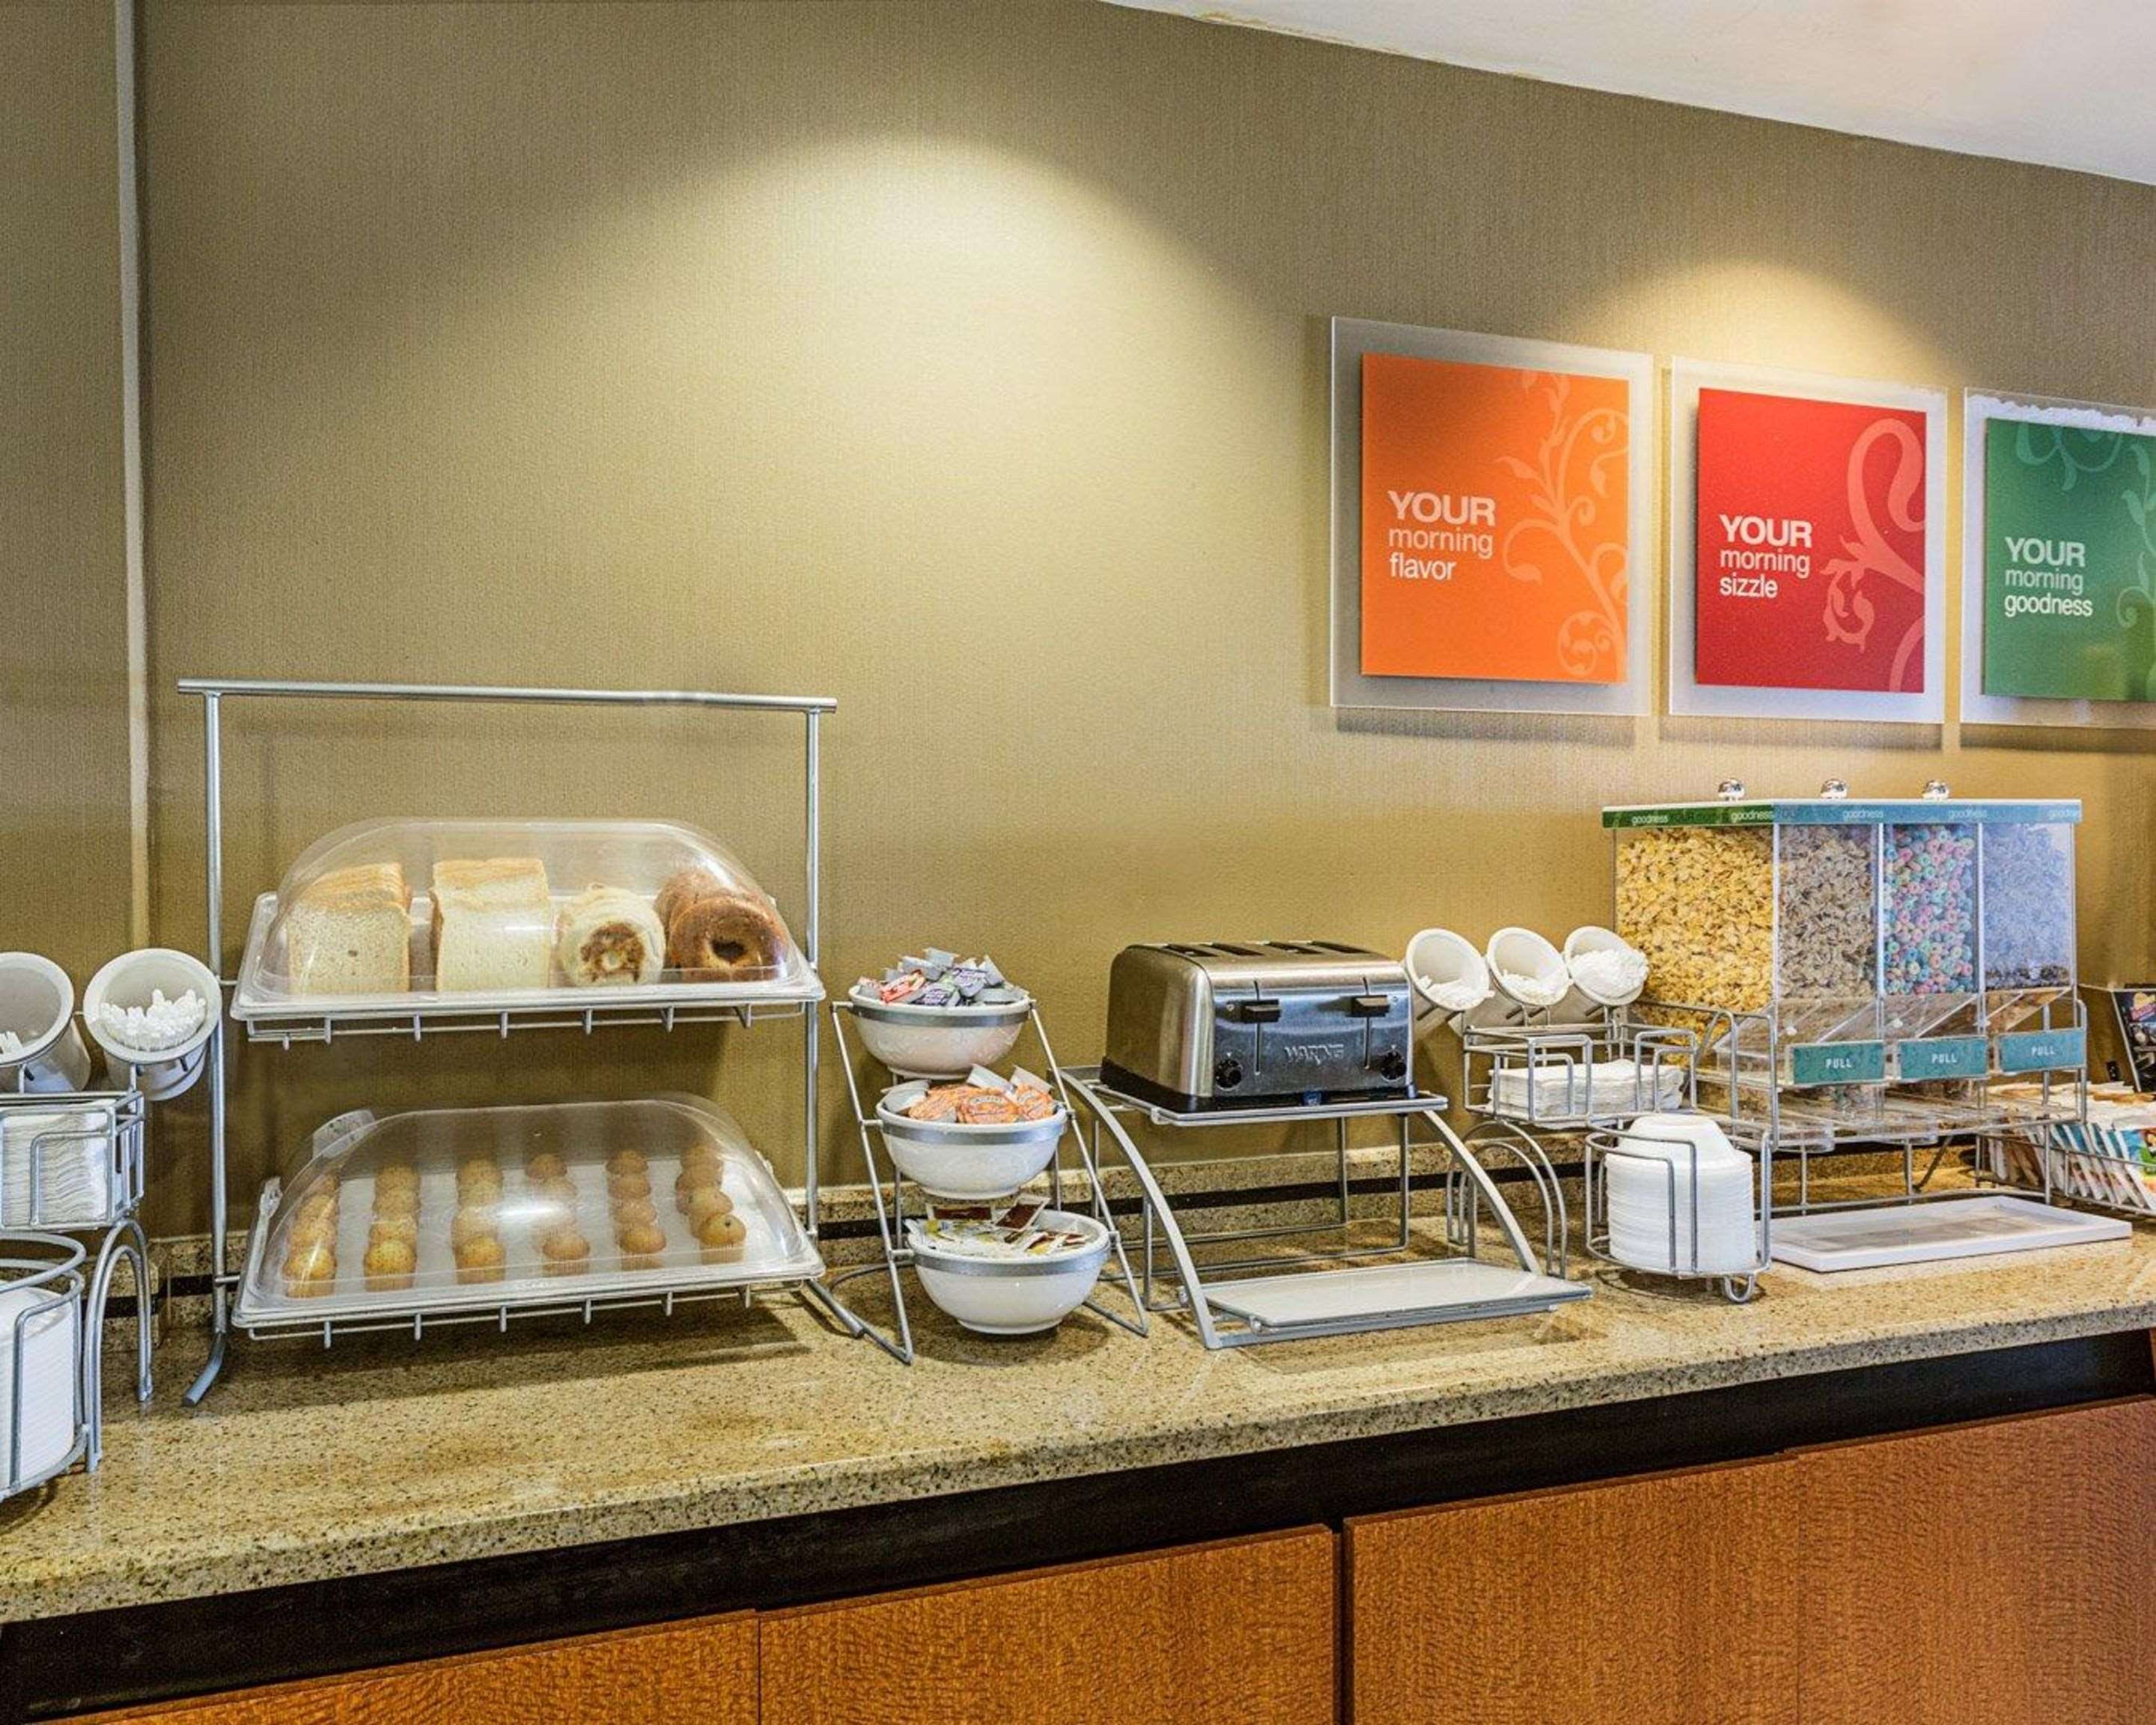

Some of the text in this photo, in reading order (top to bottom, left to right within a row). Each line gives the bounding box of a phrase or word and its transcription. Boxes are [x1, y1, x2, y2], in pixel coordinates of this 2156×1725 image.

[1387, 490, 1496, 526] YOUR
[1389, 526, 1493, 560] morning
[1719, 514, 1812, 548] YOUR
[1720, 548, 1810, 579] morning
[2004, 536, 2086, 567] YOUR
[1389, 551, 1457, 581] flavor
[1720, 571, 1779, 598] sizzle
[2005, 568, 2083, 596] morning
[2004, 592, 2094, 618] goodness
[1631, 815, 1669, 826] goodness
[1731, 810, 1773, 823] goodness
[1843, 810, 1884, 821] goodness
[1825, 1058, 1853, 1069] PULL
[1931, 1053, 1958, 1064] PULL
[2031, 1045, 2056, 1056] PULL
